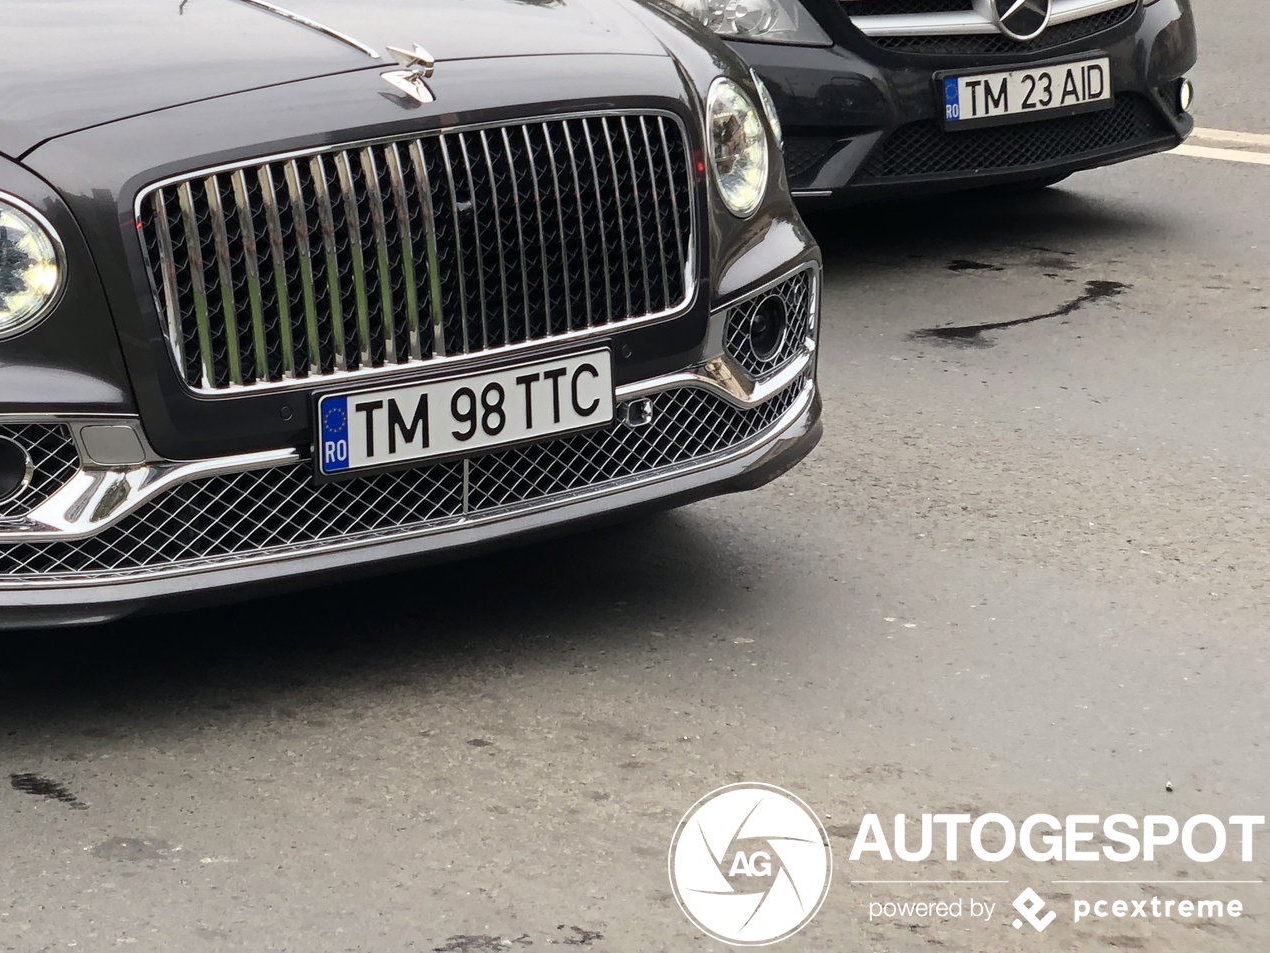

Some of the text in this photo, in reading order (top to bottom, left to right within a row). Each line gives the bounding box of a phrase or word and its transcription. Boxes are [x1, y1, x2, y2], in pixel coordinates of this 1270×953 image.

[965, 64, 1104, 116] TM 23 AID
[946, 103, 959, 119] RO
[355, 363, 600, 458] TM 98 TTC
[325, 439, 347, 463] RO
